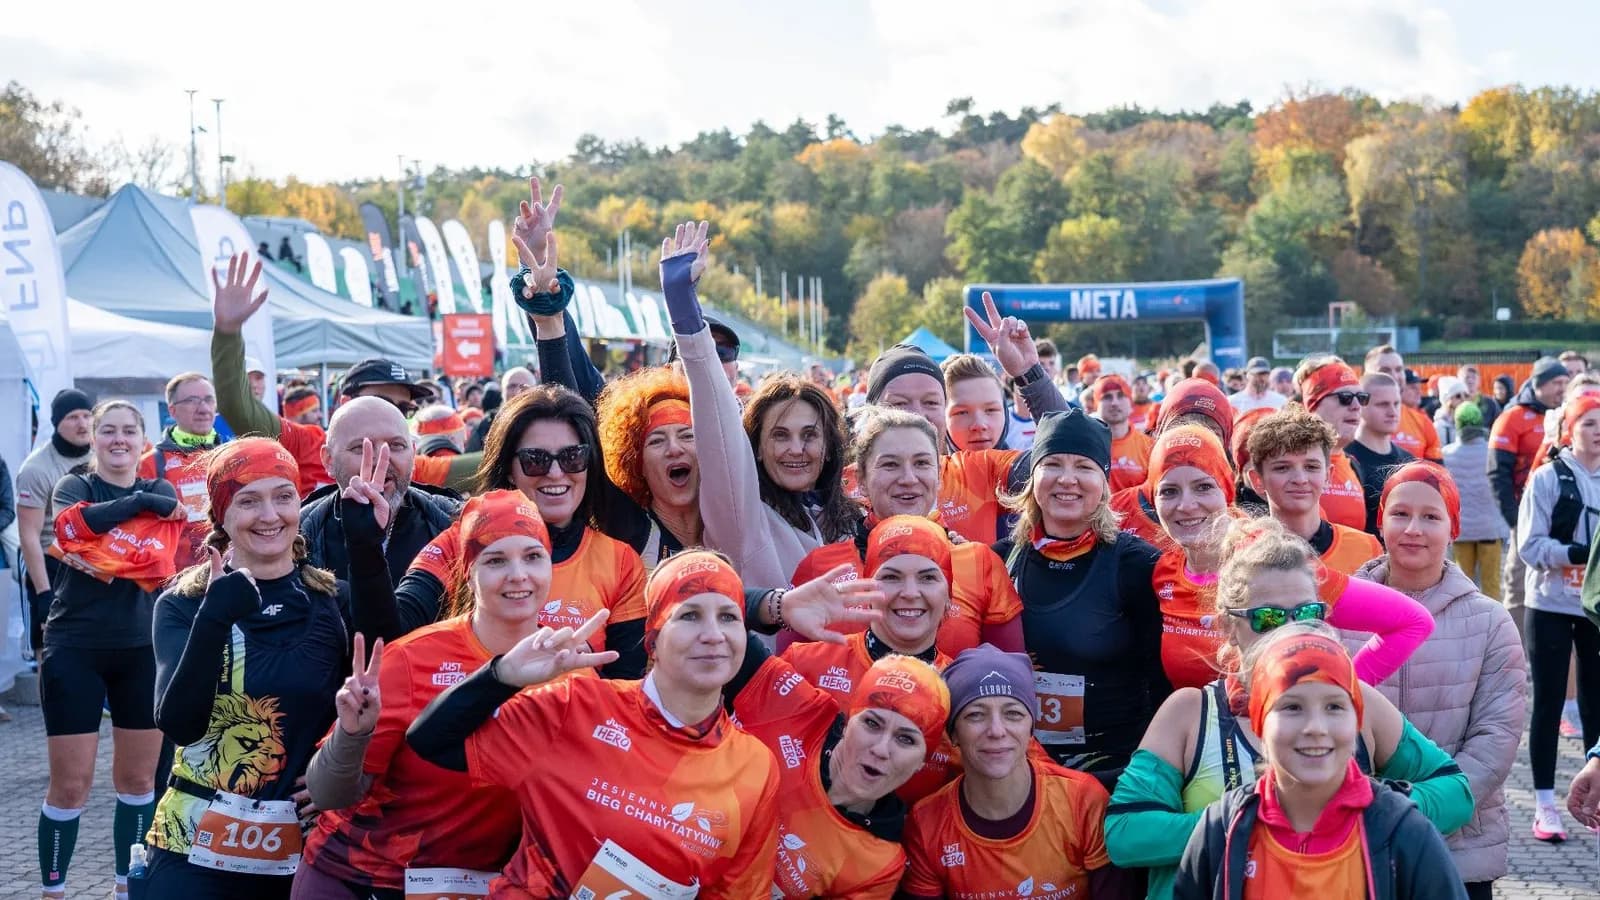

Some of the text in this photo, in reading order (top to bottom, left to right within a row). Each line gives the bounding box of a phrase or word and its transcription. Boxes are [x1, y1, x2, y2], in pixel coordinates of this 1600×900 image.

[1070, 289, 1138, 320] META
[262, 604, 283, 616] 4F
[827, 665, 848, 676] JUST
[821, 676, 851, 691] HERO
[880, 677, 914, 690] HERO
[597, 727, 630, 748] HERO
[781, 738, 799, 766] HERO
[591, 777, 668, 813] JESIENNY
[586, 788, 723, 849] BIEG CHARYTATYWNY
[222, 822, 282, 853] 106
